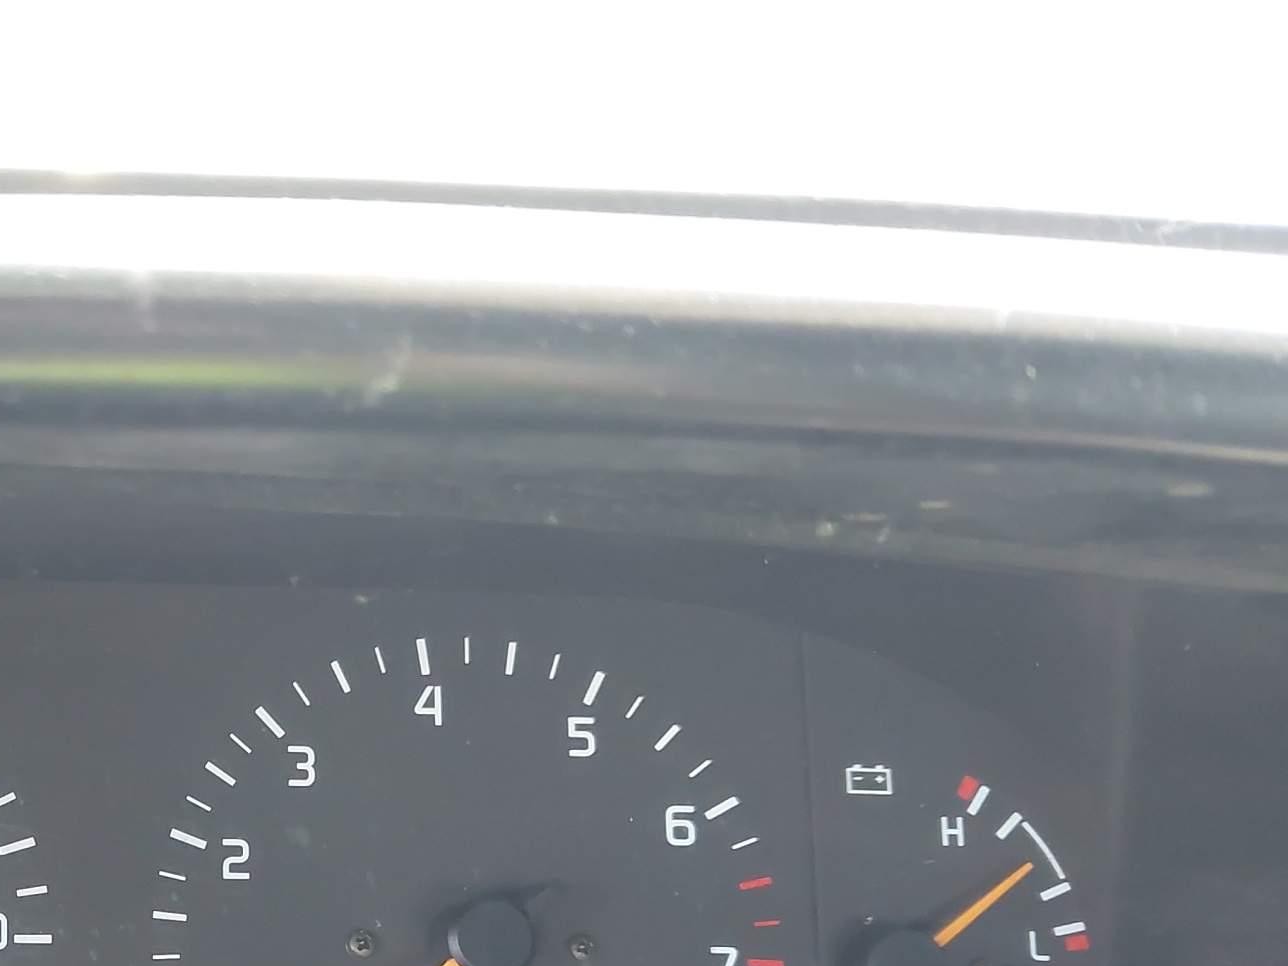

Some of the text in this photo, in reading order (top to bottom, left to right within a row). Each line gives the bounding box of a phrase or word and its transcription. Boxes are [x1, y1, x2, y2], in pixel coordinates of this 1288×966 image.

[413, 685, 443, 726] 4
[567, 716, 597, 757] 5
[287, 745, 317, 787] 3
[664, 804, 696, 846] 6
[940, 816, 965, 847] H
[221, 838, 251, 880] 2
[1028, 930, 1051, 962] L
